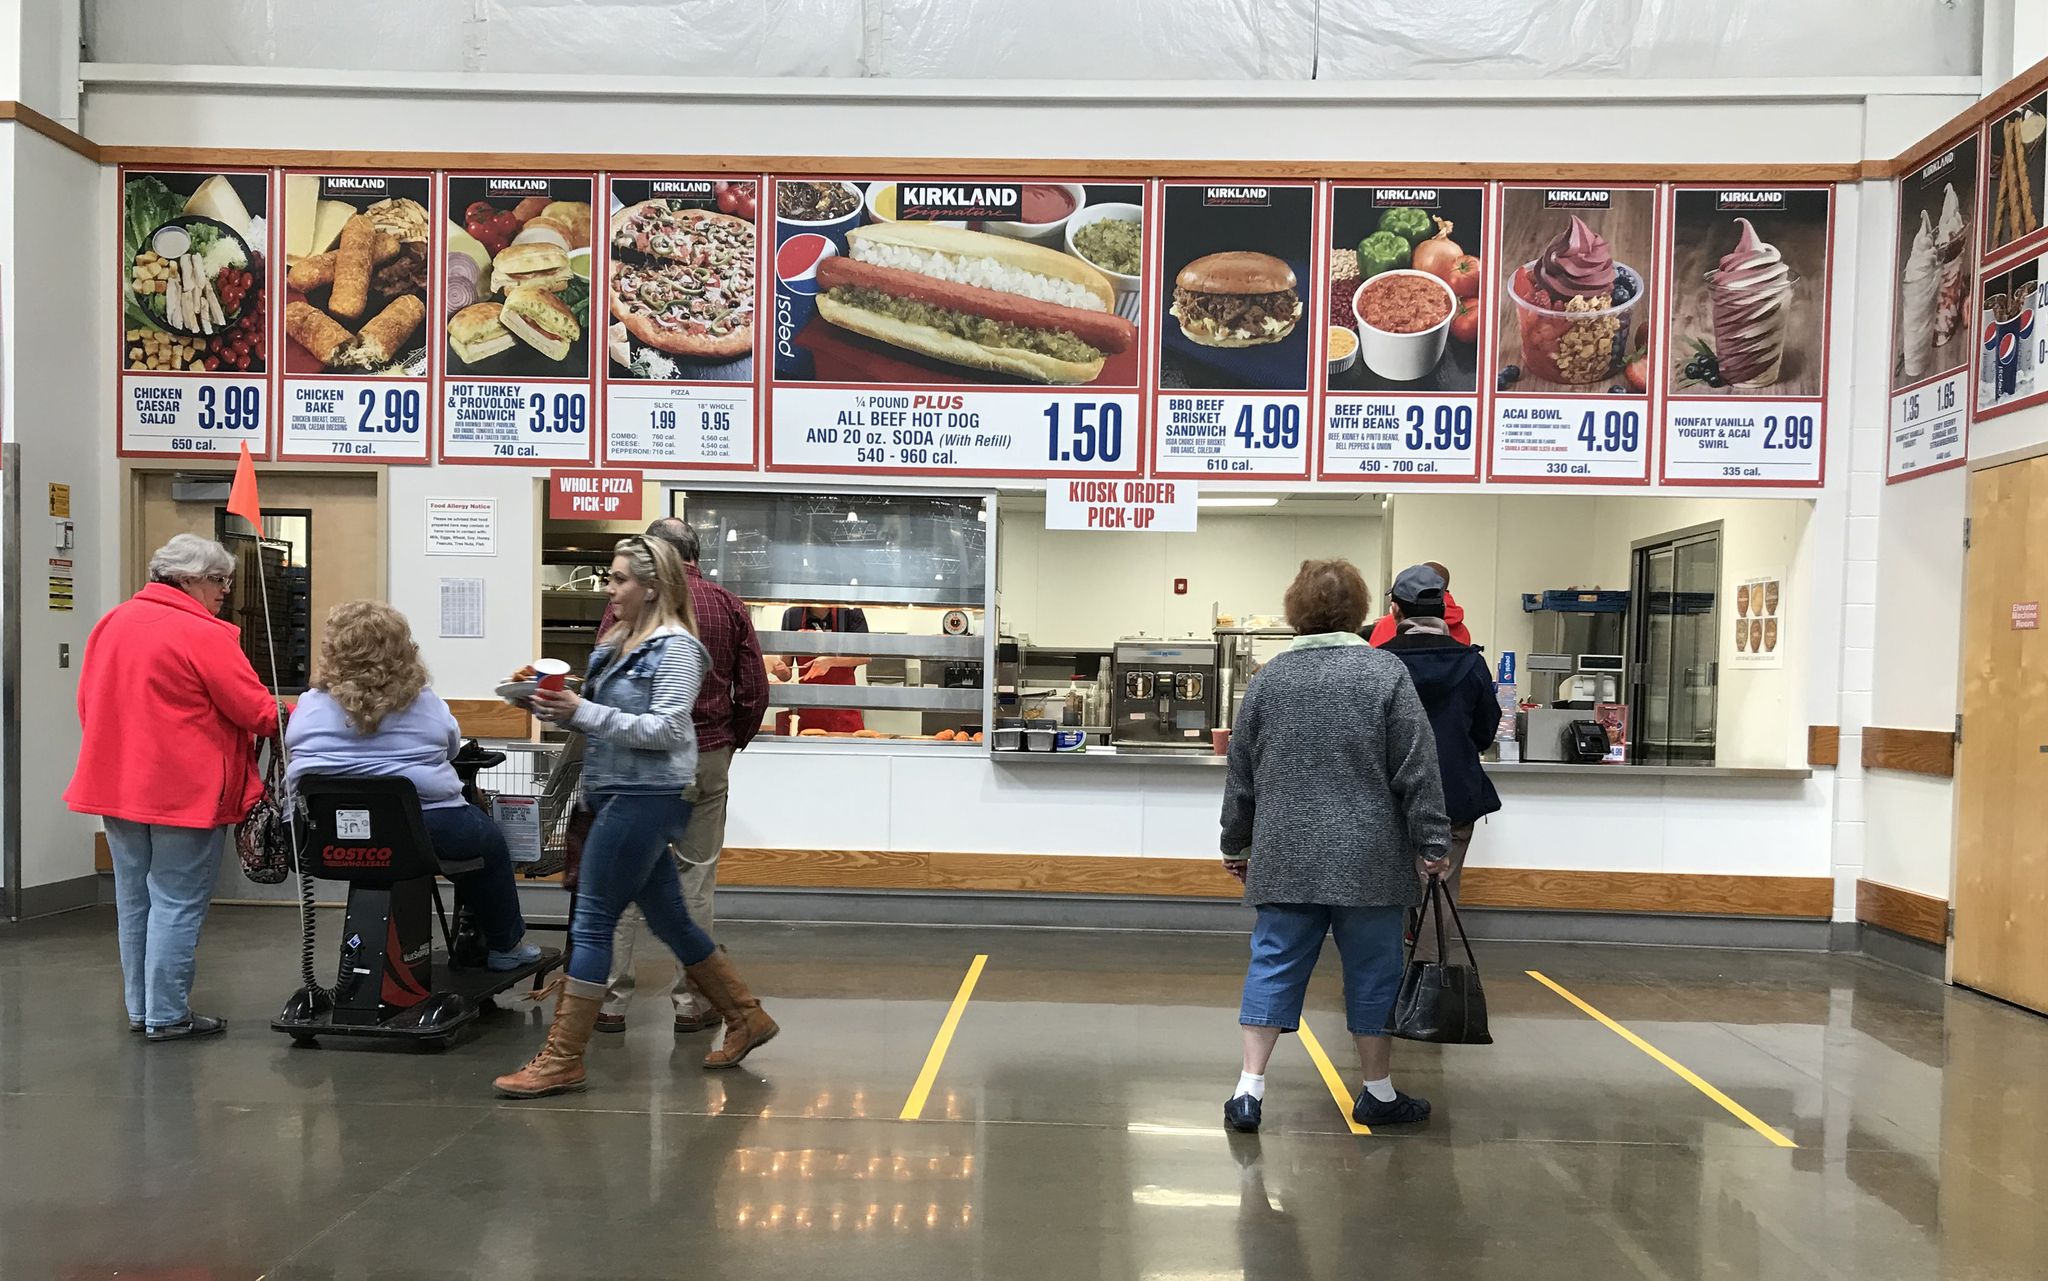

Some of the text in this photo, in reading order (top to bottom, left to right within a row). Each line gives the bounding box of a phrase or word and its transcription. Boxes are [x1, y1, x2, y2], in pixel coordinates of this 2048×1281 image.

[1923, 152, 1954, 179] KIRKLAND
[328, 178, 385, 188] KIRKLAND
[490, 180, 547, 190] KIRKLAND
[653, 182, 711, 192] KIRKLAND
[904, 187, 1017, 206] KIRKLAND
[1208, 188, 1266, 198] KIRKLAND
[1376, 189, 1436, 199] KIRKLAND
[1548, 191, 1609, 201] KIRKLAND
[1720, 192, 1782, 202] KIRKLAND
[903, 206, 1017, 220] Signature
[777, 293, 795, 358] pepsi
[134, 387, 182, 400] CHICKEN
[296, 388, 344, 401] CHICKEN
[452, 385, 521, 398] HOT TURKEY
[1937, 381, 1955, 411] 1.65
[136, 400, 180, 412] CAESAR
[198, 385, 260, 430] 3.99
[305, 402, 334, 413] BAKE
[448, 397, 525, 409] & PROVOLONE
[869, 397, 909, 409] POUND
[913, 395, 964, 410] PLUS
[1169, 399, 1225, 411] BBQ BEEF
[1903, 394, 1920, 423] 1.35
[358, 389, 420, 433] 2.99
[456, 409, 516, 421] SANDWICH
[529, 393, 585, 433] 3.99
[1335, 404, 1395, 416] BEEF CHILI
[1503, 408, 1562, 420] ACAI BOWL
[140, 413, 175, 424] SALAD
[650, 410, 676, 429] 1.99
[702, 411, 729, 431] 9.95
[837, 411, 979, 428] ALL BEEF HOT DOG
[1172, 412, 1220, 424] BRISKET
[1330, 417, 1400, 430] WITH BEANS
[1674, 417, 1755, 427] NONFAT VANILLA
[1043, 402, 1122, 463] 1.50
[1166, 425, 1227, 437] SANDWICH
[1234, 404, 1300, 449] 4.99
[1405, 405, 1472, 450] 3.99
[1577, 410, 1639, 452] 4.99
[1678, 428, 1750, 438] YOGURT & ACAI
[1763, 415, 1813, 450] 2.99
[172, 438, 216, 451] 650 cal.
[806, 428, 1012, 450] AND 20 oz. SODA (With Refill)
[1698, 439, 1729, 449] SWIRL
[332, 442, 376, 454] 770 cal.
[493, 445, 539, 457] 740 cal.
[1348, 442, 1370, 450] PEPPERS
[857, 448, 885, 463] 540
[900, 448, 927, 463] 960
[932, 448, 958, 465] cal.
[1207, 459, 1253, 471] 610 cal.
[1359, 460, 1381, 472] 450
[1392, 461, 1413, 472] 700
[1416, 461, 1438, 472] cal.
[1546, 462, 1591, 474] 330 cal.
[1722, 466, 1761, 476] 335 cal.
[560, 478, 633, 494] WHOLE PIZZA
[1069, 482, 1175, 504] KIOSK ORDER
[573, 496, 620, 512] PICK-UP
[1088, 507, 1155, 528] PICK-UP
[2016, 620, 2034, 628] Room
[323, 845, 392, 860] COSTCO
